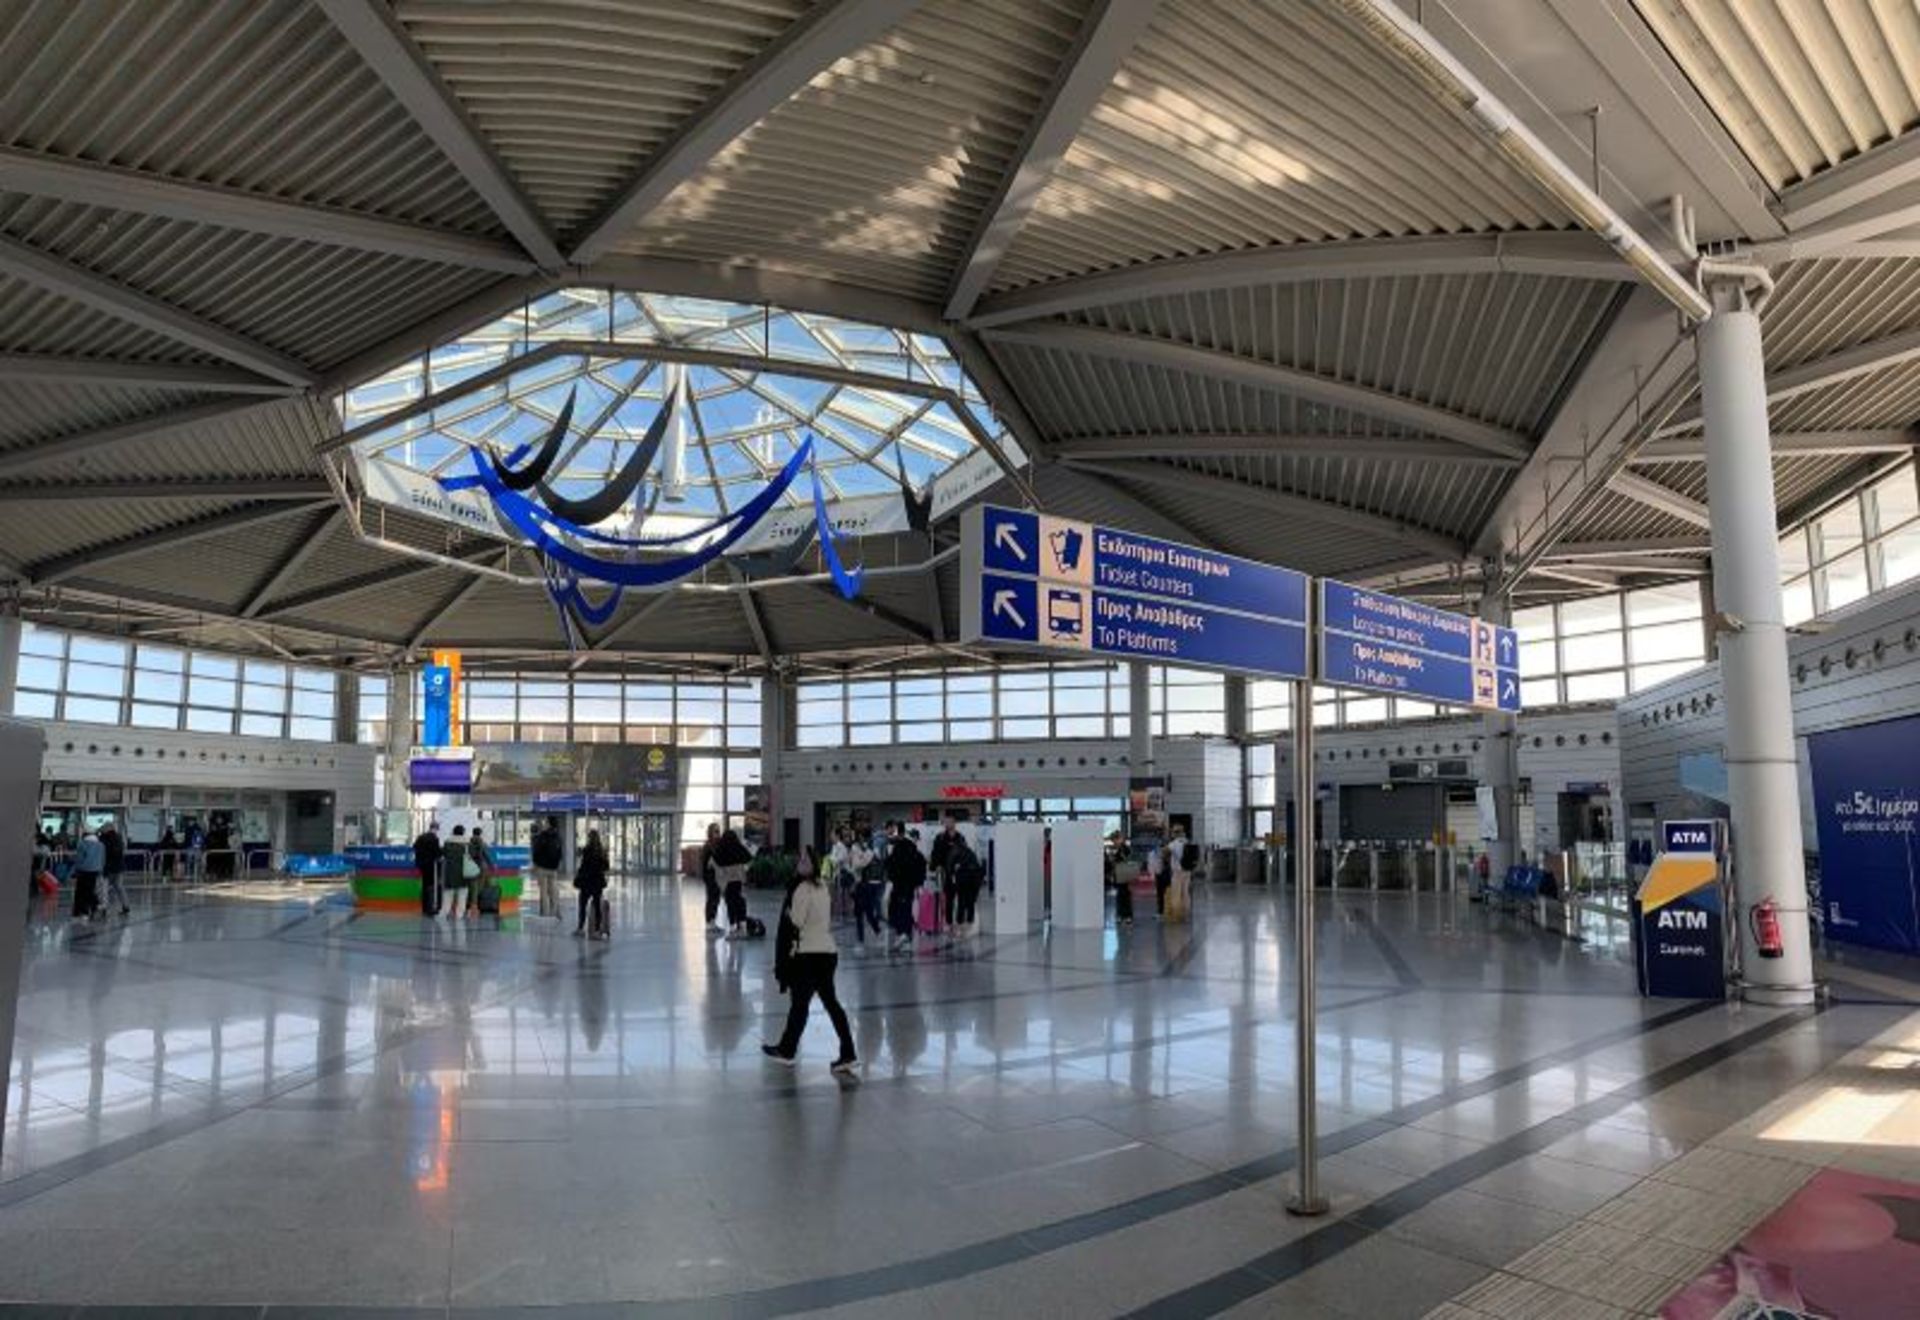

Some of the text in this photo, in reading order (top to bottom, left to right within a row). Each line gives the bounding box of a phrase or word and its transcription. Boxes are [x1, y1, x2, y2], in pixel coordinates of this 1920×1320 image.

[1099, 563, 1194, 596] Ticket Counters
[1097, 597, 1132, 622] Προς
[1097, 626, 1178, 653] To Platforms
[1672, 832, 1707, 844] ATM
[1658, 911, 1708, 929] ATM
